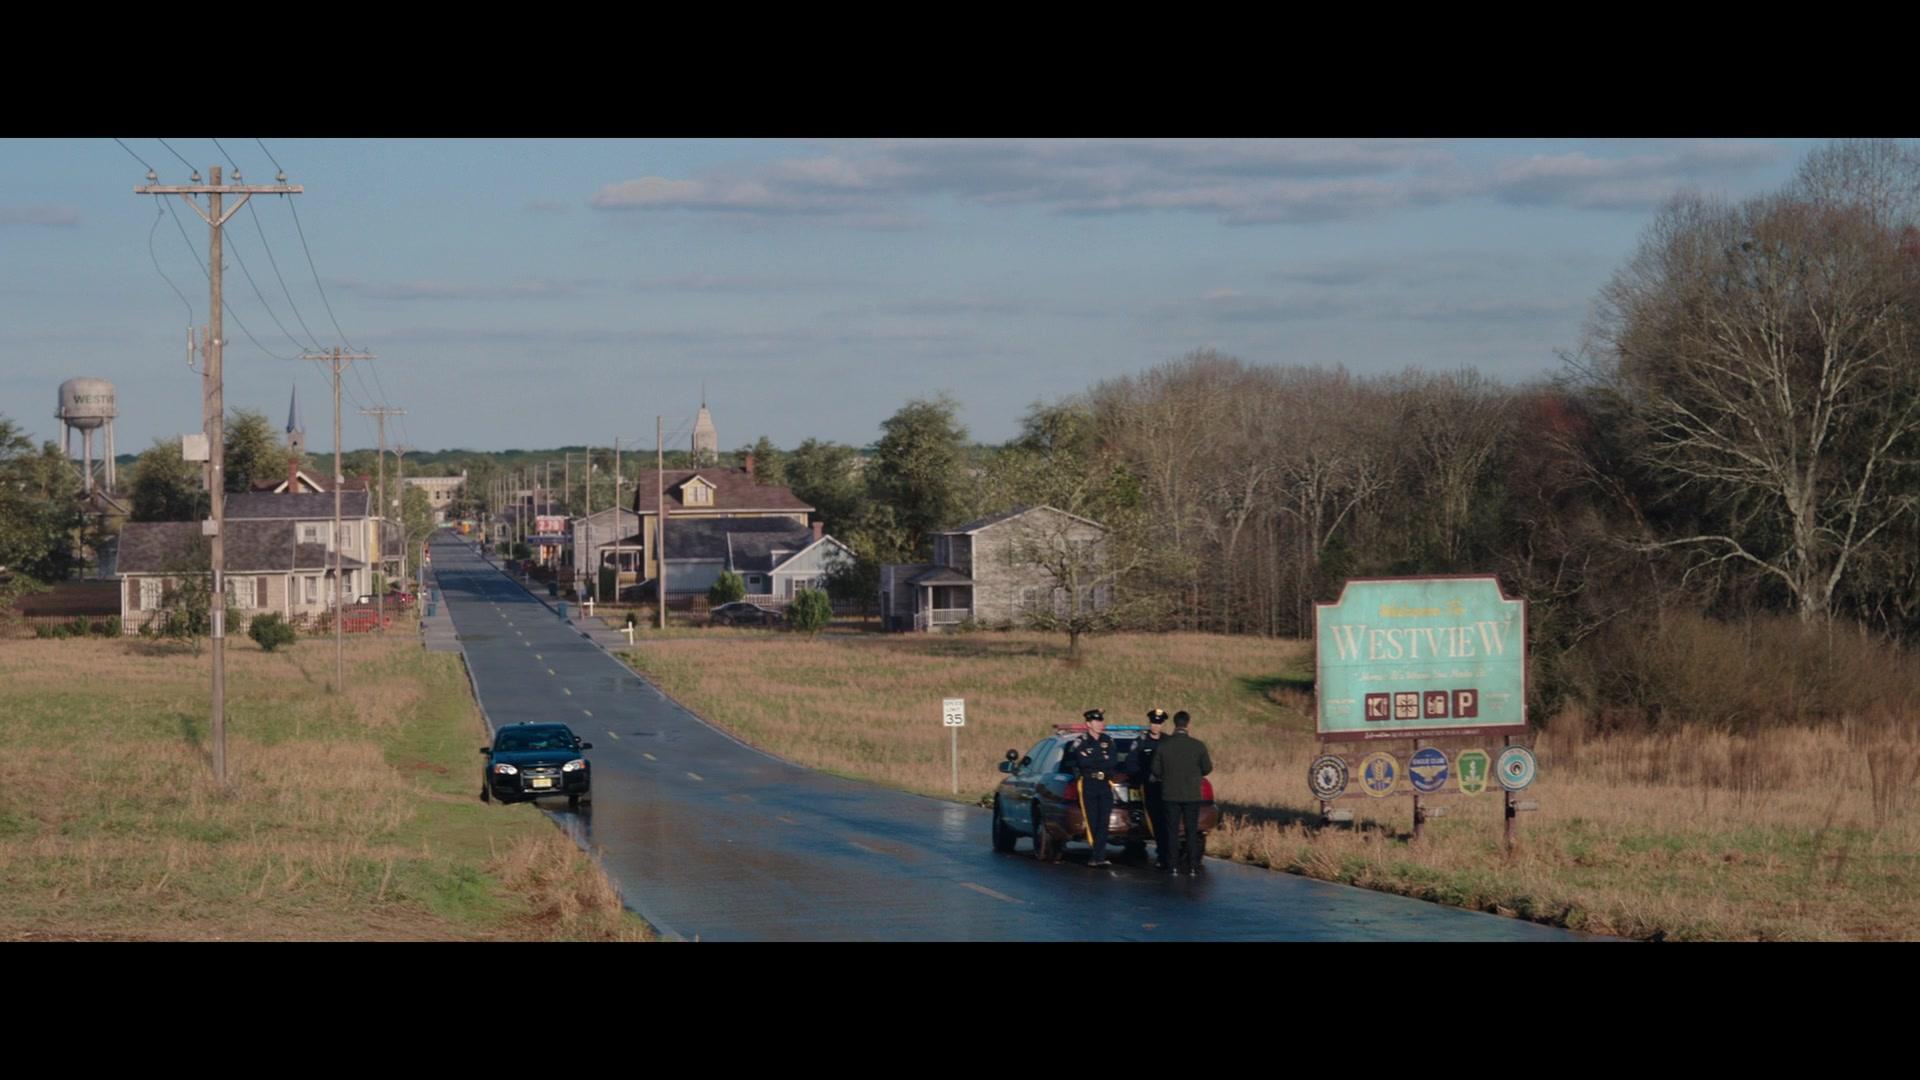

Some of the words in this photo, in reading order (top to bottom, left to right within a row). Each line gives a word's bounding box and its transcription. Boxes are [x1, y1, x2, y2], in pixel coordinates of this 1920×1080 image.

[1331, 620, 1511, 661] WESTVIEW
[1458, 692, 1474, 716] P
[946, 713, 962, 724] 35
